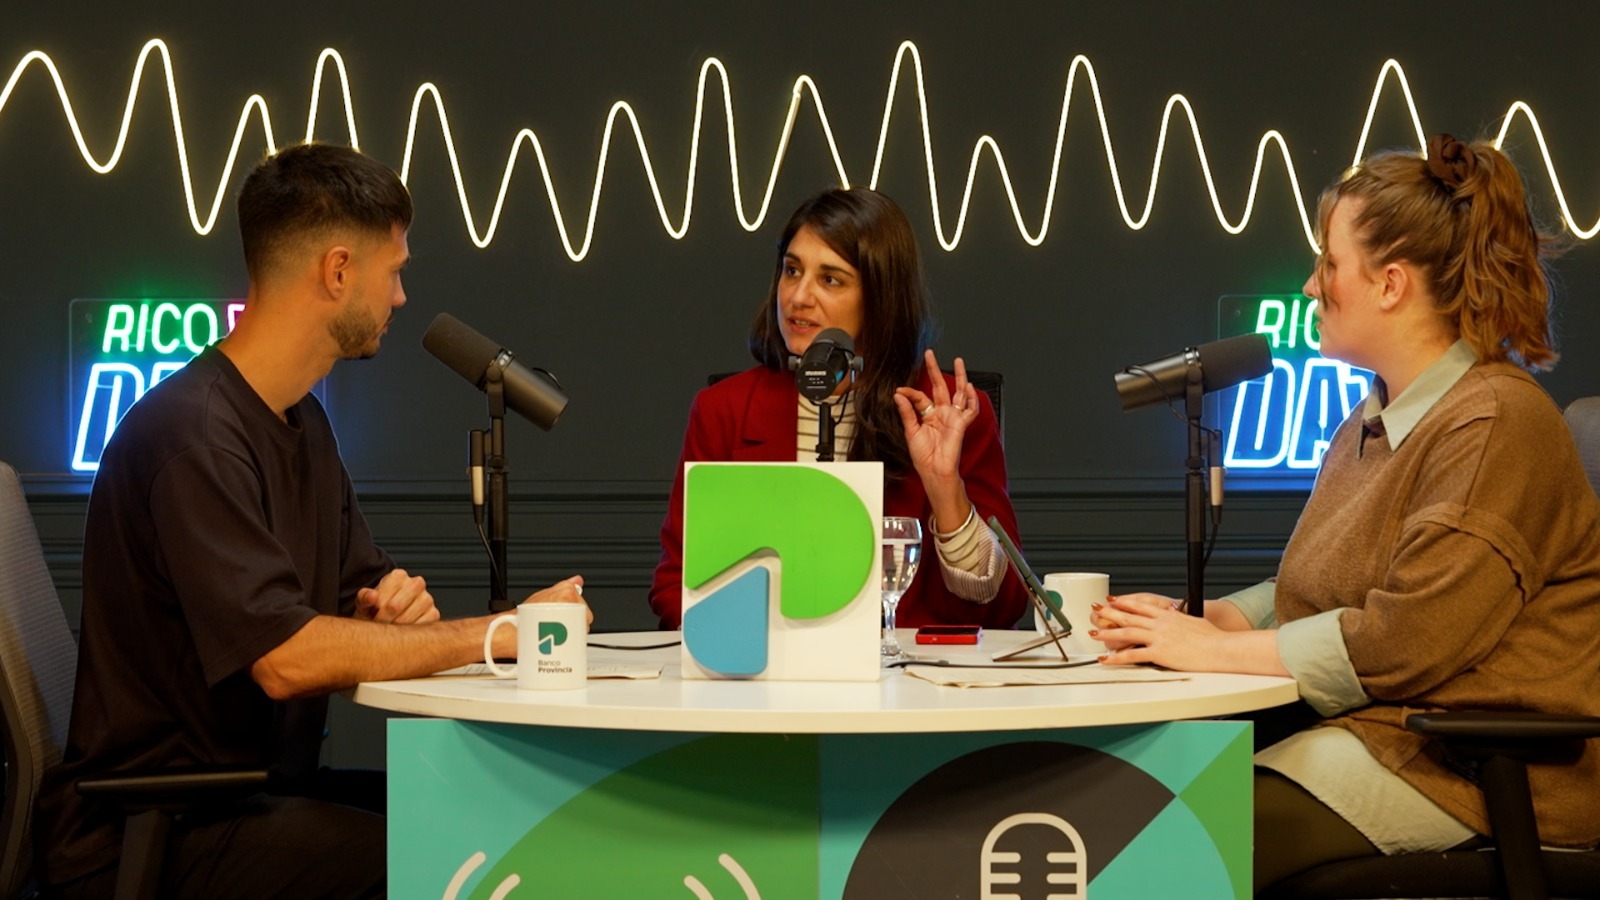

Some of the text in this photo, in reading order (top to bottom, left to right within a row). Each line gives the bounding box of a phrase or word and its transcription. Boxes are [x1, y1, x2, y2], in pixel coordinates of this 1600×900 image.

[102, 303, 218, 354] RICO
[1256, 299, 1321, 350] RIC
[1224, 358, 1371, 468] DA
